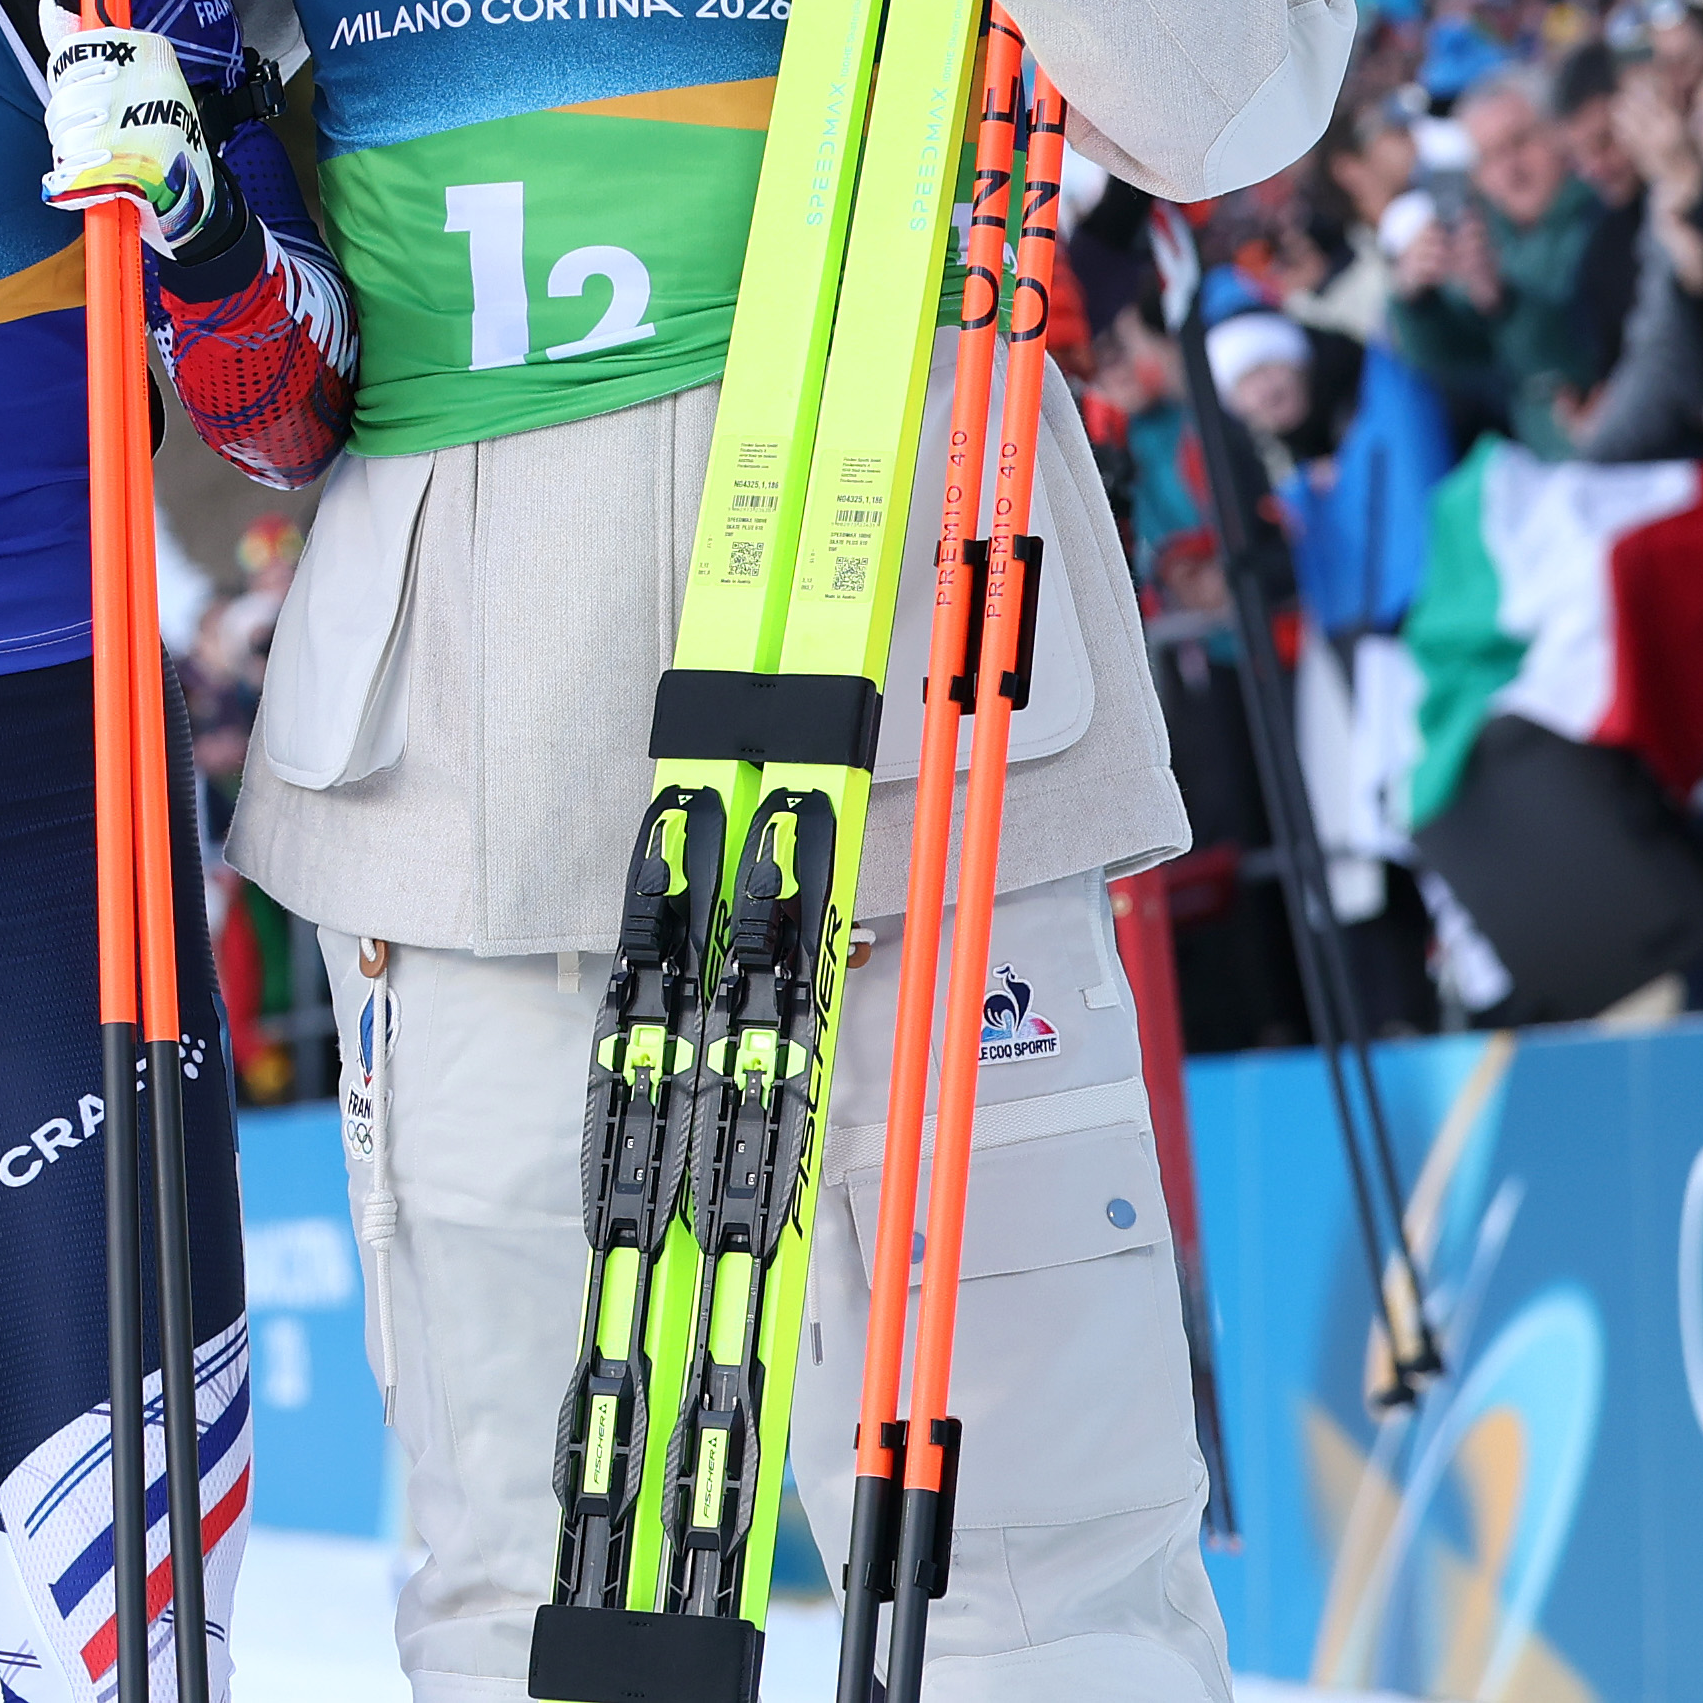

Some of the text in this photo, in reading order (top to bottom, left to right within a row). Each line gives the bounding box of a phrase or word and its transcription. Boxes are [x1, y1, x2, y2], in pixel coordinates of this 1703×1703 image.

[937, 429, 968, 605] PREMIO 40
[987, 442, 1018, 619] PREMIO 40
[978, 1038, 1058, 1061] E COQ SPORTIF
[347, 1089, 373, 1119] FRAN
[594, 1415, 606, 1485] FISCHER
[704, 1450, 716, 1519] FISCHER
